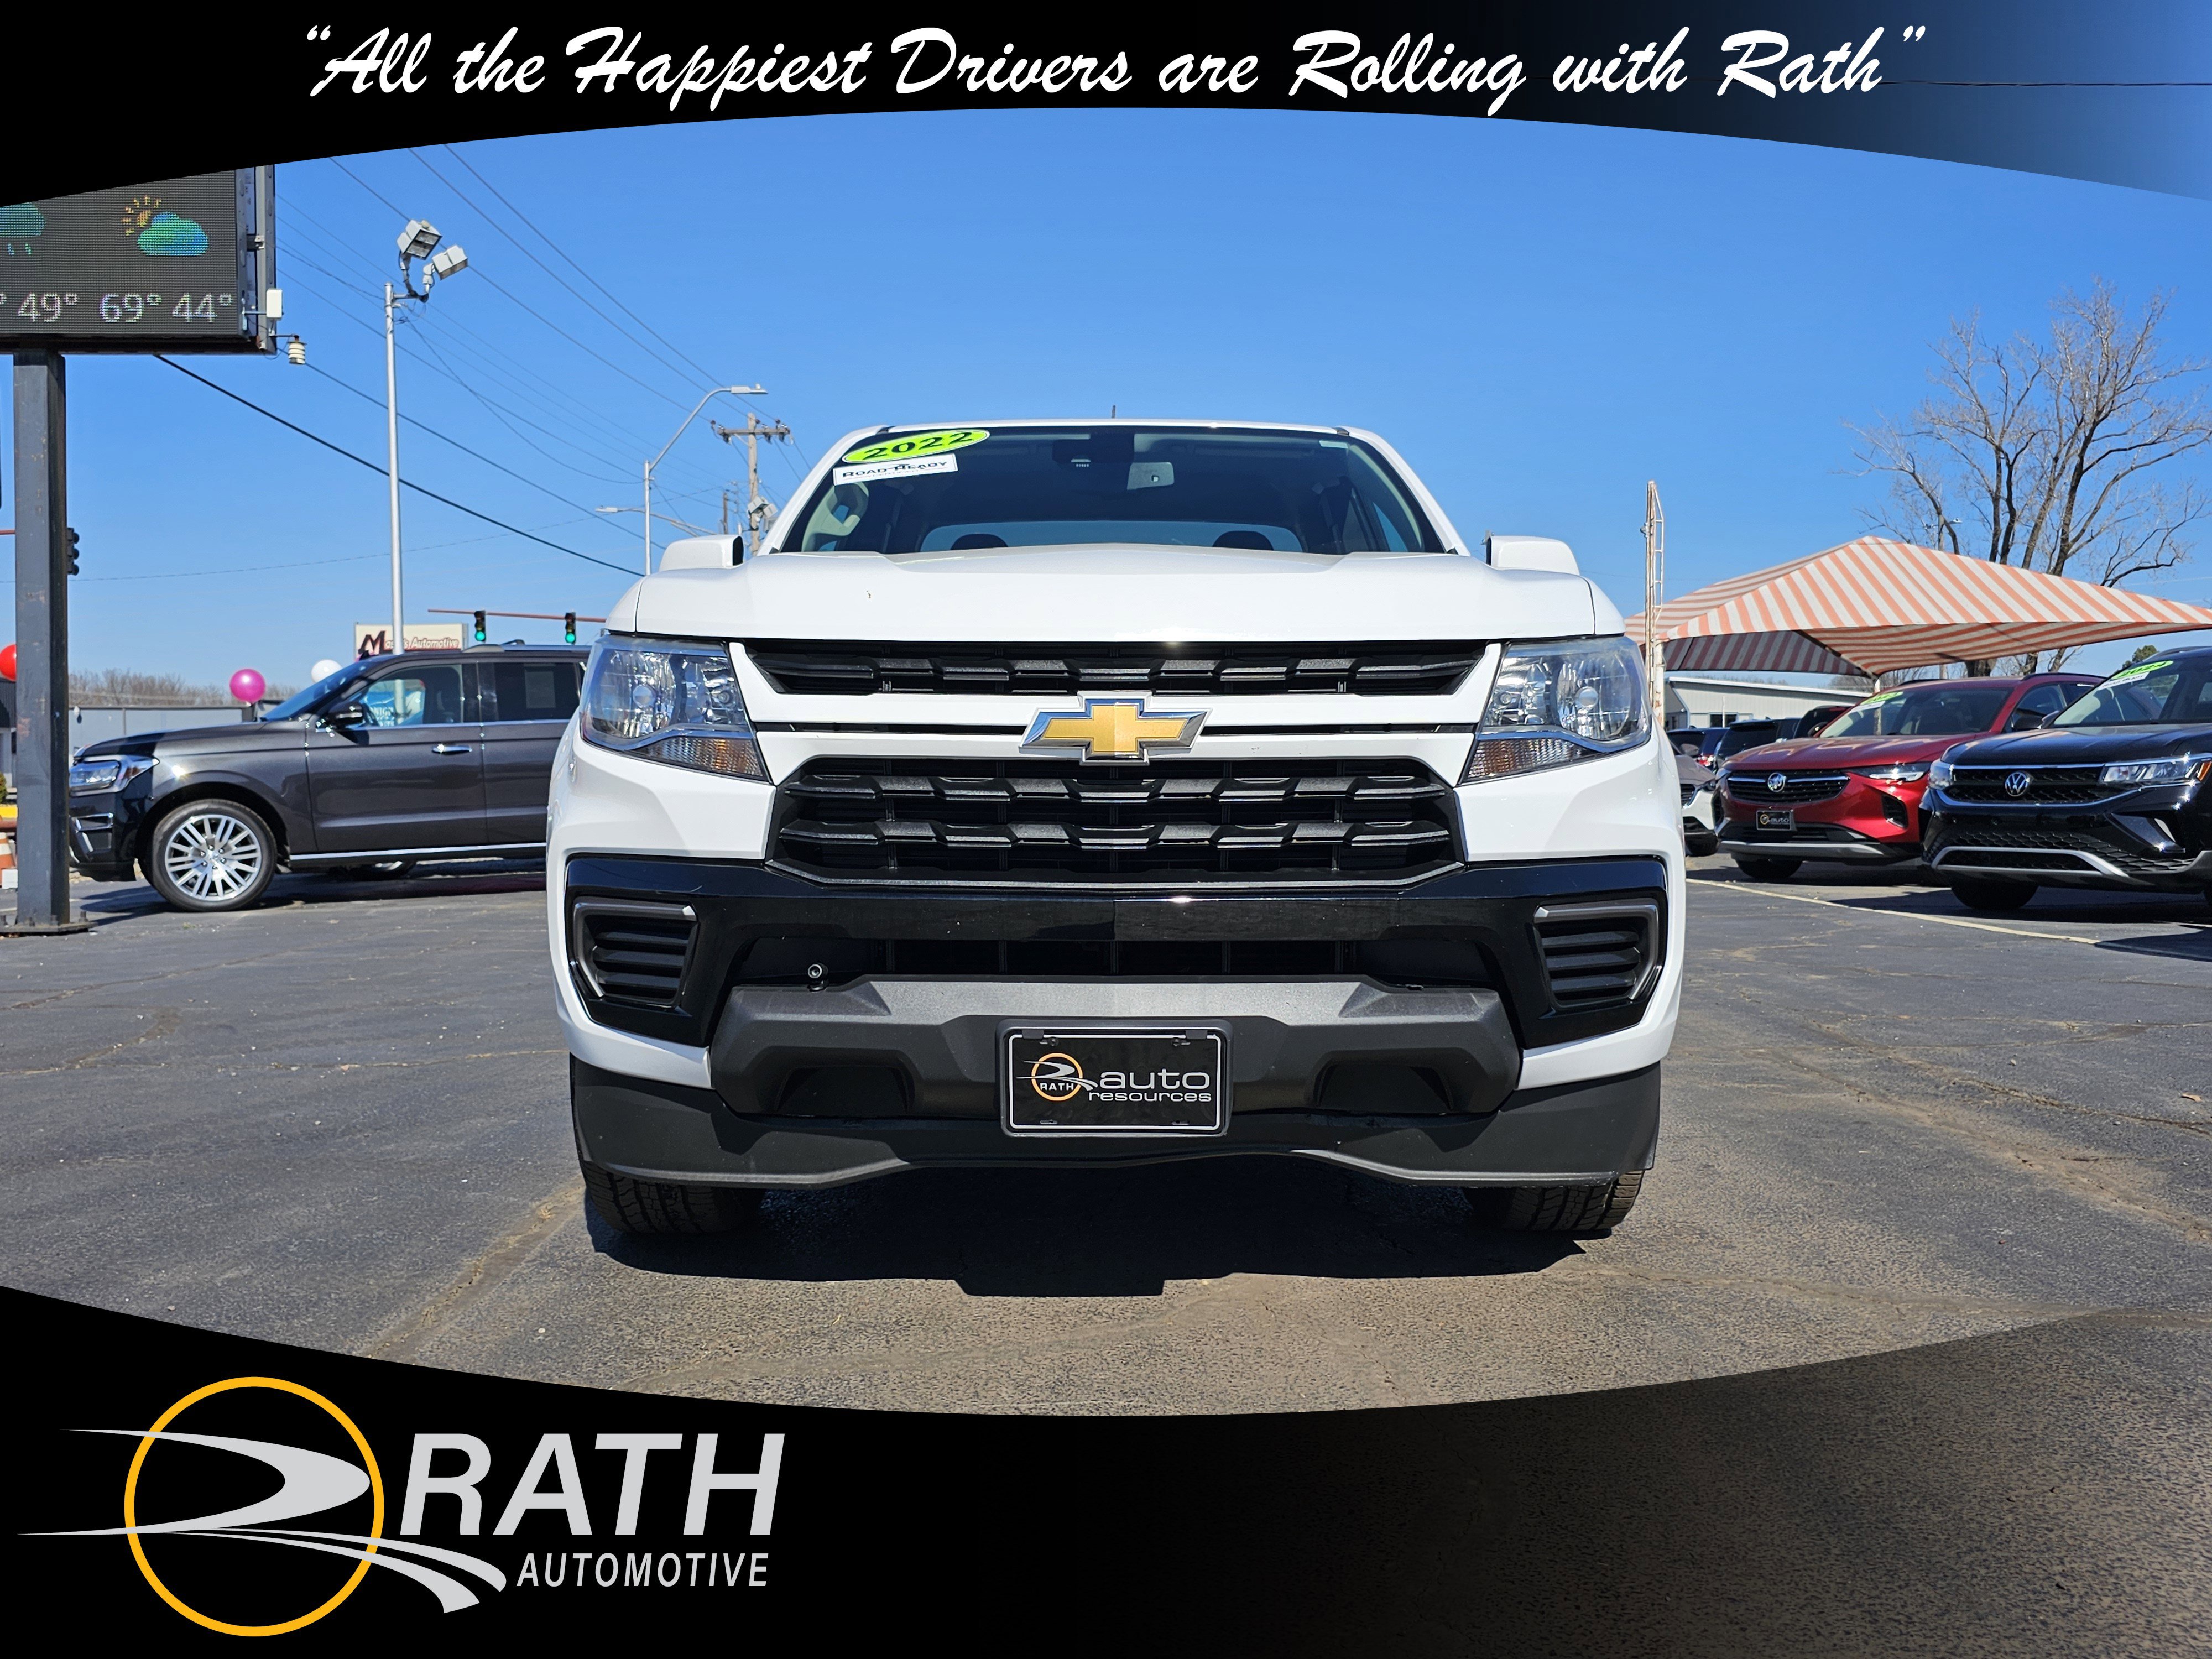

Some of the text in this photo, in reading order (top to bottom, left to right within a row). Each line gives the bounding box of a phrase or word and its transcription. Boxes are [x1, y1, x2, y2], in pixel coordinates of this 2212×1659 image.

[862, 432, 974, 460] 2022
[842, 461, 948, 477] ROAD READY
[411, 637, 459, 649] Automotive
[1100, 1069, 1210, 1089] auto
[1089, 1092, 1212, 1102] resources
